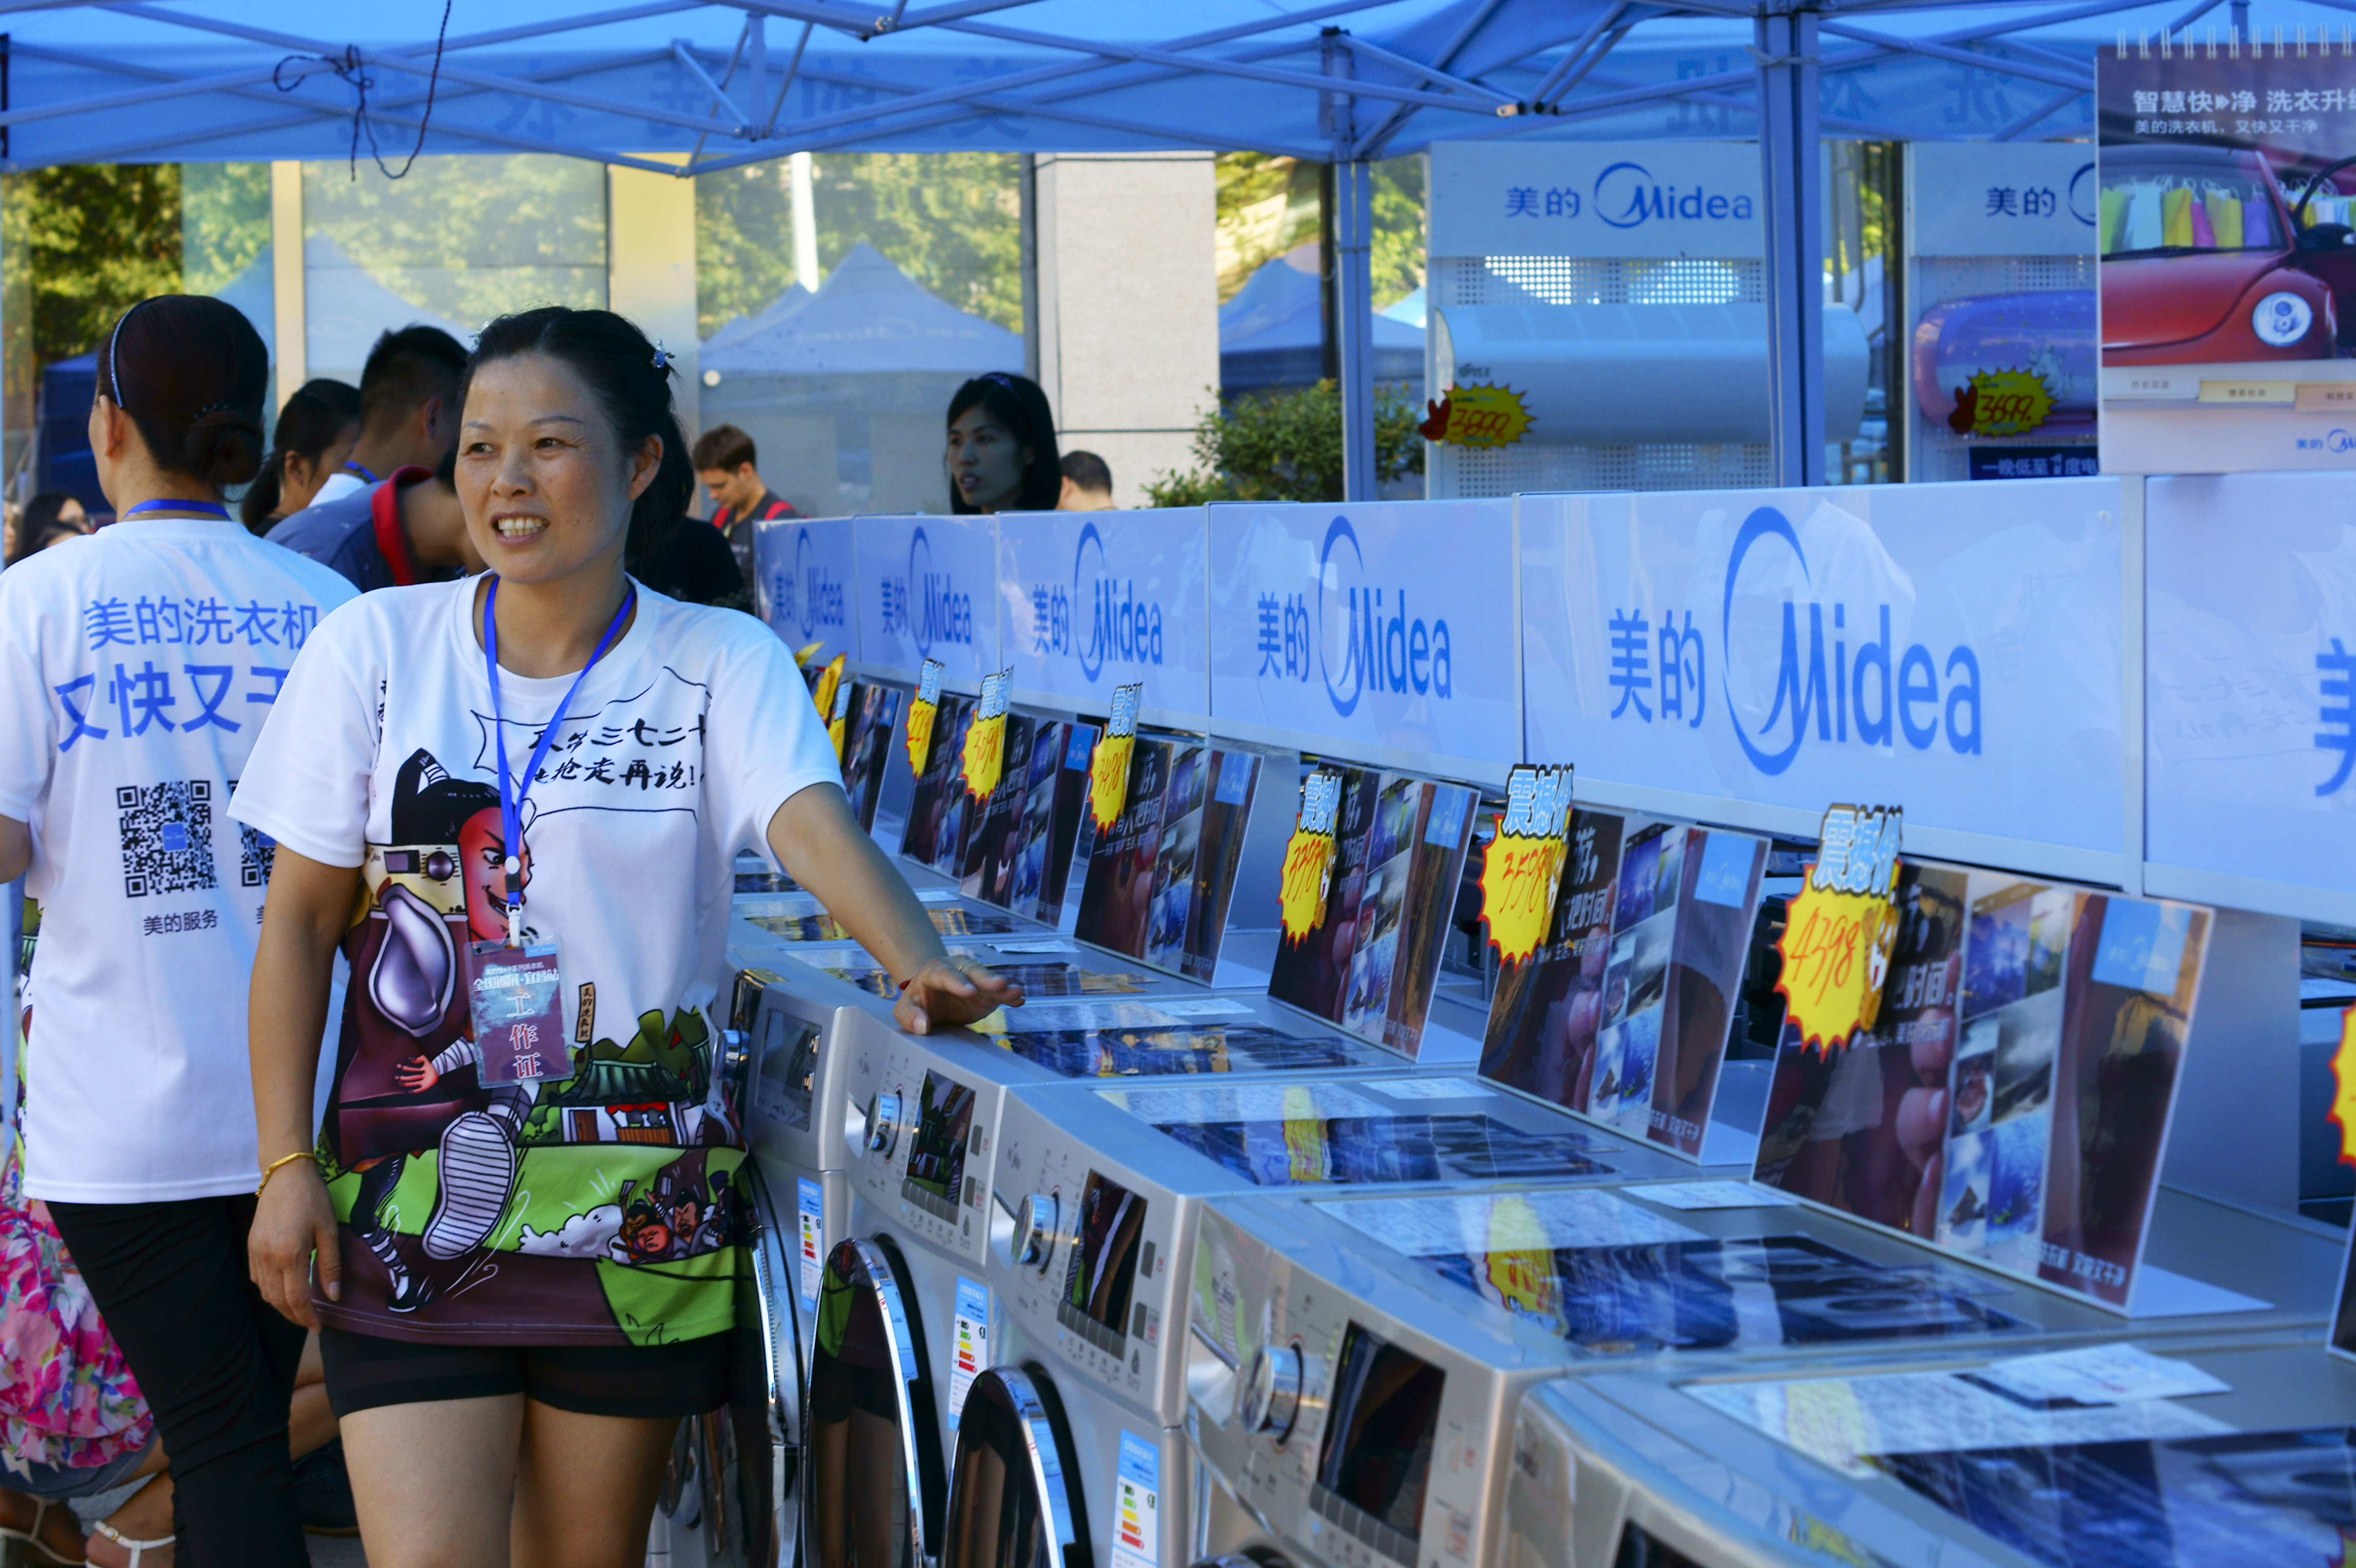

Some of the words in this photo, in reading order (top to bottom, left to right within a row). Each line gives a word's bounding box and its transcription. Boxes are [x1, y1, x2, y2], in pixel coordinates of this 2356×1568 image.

[1505, 186, 1581, 220] 美的
[1595, 185, 1753, 229] Midea
[1985, 186, 2057, 218] 美的
[84, 595, 318, 652] 美的洗衣机
[797, 566, 845, 640] Midea
[880, 576, 907, 636] 美的
[911, 572, 972, 657] Midea
[1032, 583, 1069, 655] 美的
[1076, 578, 1164, 683] Midea
[1258, 592, 1310, 683] 美的
[1319, 587, 1452, 718] Midea
[1608, 608, 1706, 728] 美的
[1722, 601, 1982, 776] Midea
[1501, 768, 1574, 837] 震撼价
[1499, 841, 1548, 920] 3598
[143, 909, 218, 936] 美的服务
[1789, 906, 1860, 1007] 4398
[506, 992, 544, 1080] 工作证
